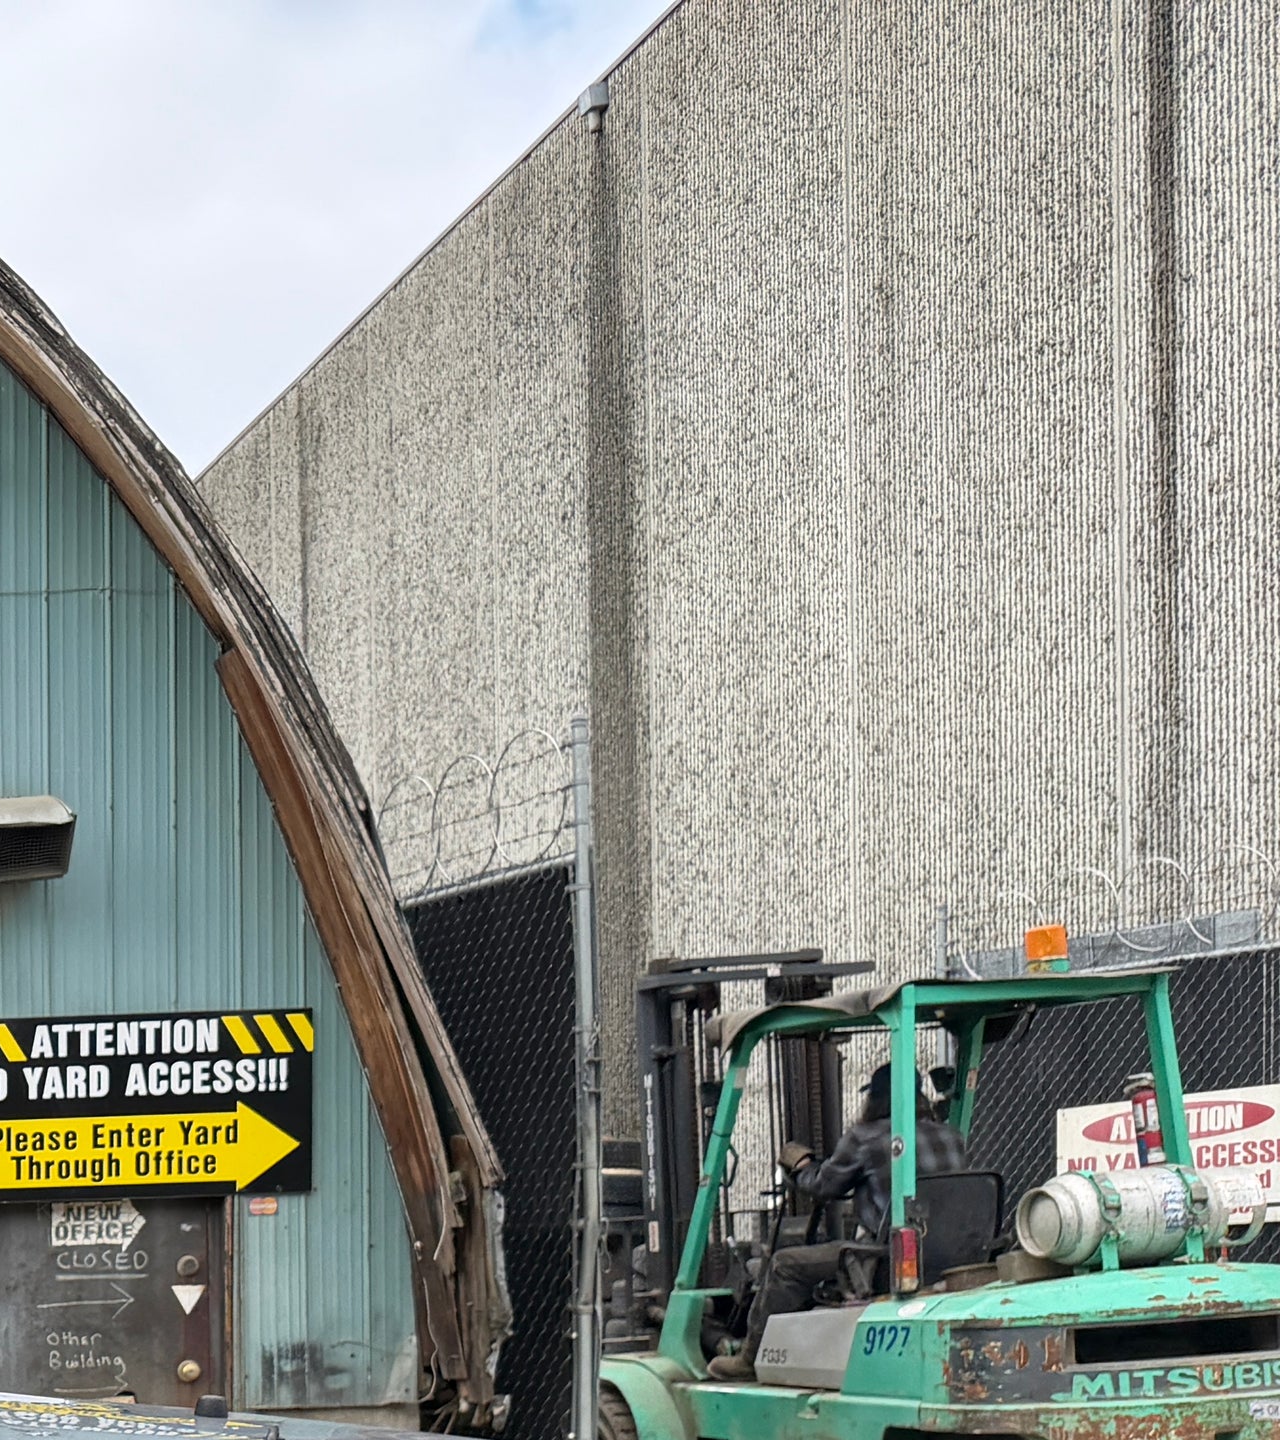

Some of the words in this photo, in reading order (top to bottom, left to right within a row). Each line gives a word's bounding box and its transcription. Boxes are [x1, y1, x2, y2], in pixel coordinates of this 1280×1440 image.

[30, 1018, 220, 1059] ATTENTION
[22, 1064, 111, 1100] YARD
[124, 1057, 289, 1097] ACCESS!!!
[91, 1122, 166, 1149] Enter
[178, 1118, 239, 1147] Yard
[1110, 1103, 1243, 1141] ATTION
[11, 1153, 121, 1184] Through
[135, 1150, 217, 1176] Office
[1196, 1139, 1280, 1170] CCESS!
[66, 1204, 120, 1221] NEW
[54, 1220, 136, 1240] OFFICE
[56, 1249, 149, 1270] CLOSED
[46, 1330, 102, 1346] Other
[48, 1350, 127, 1376] Building
[1070, 1358, 1280, 1401] MITSUBI
